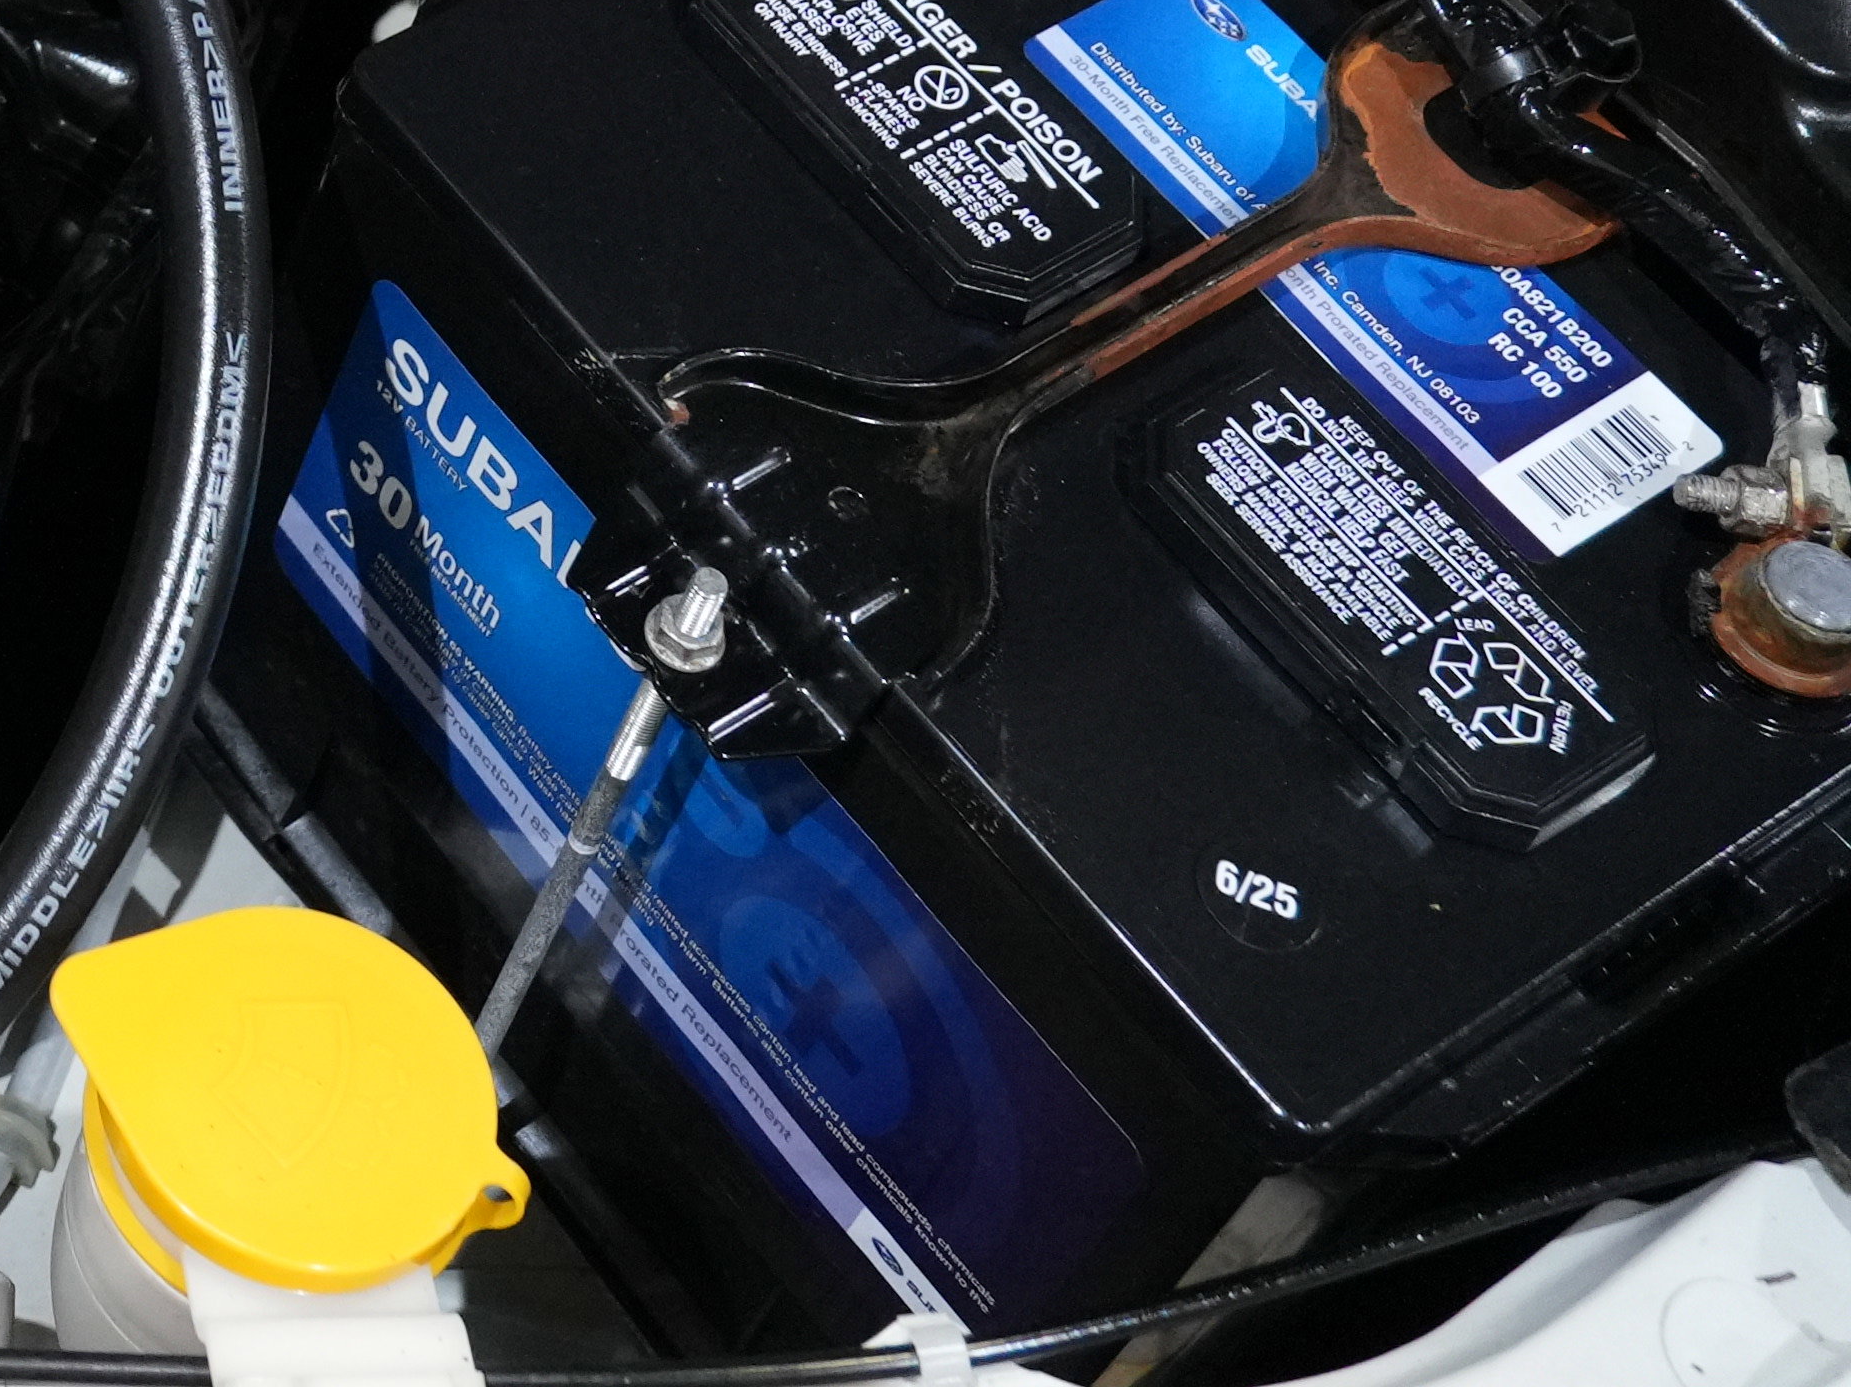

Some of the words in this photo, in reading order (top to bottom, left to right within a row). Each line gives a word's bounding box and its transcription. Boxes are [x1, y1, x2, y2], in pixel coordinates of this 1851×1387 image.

[750, 1, 776, 22] OR
[767, 18, 812, 58] INJURY
[788, 20, 851, 78] BLINDNESS
[843, 5, 886, 44] EYES
[893, 84, 929, 114] NO
[987, 77, 1103, 184] POISON
[905, 160, 957, 207] SEVERE
[949, 205, 998, 249] BURNS
[919, 153, 991, 221] BLINDNESS
[984, 219, 1012, 242] OR
[932, 146, 966, 175] CAN
[958, 172, 1006, 216] CAUSE
[944, 137, 1021, 208] SULFURIC
[1010, 203, 1056, 243] ACID
[1067, 53, 1133, 115] 30-Month
[1127, 113, 1163, 146] Free
[1315, 299, 1380, 361] Prorated
[1374, 360, 1470, 452] Replacement
[1088, 39, 1168, 114] Distributed
[1157, 111, 1190, 138] by:
[1182, 134, 1240, 186] Subaru
[1231, 183, 1257, 204] of
[1310, 260, 1345, 290] Inc.
[1337, 288, 1411, 357] Camden,
[1404, 353, 1434, 379] NJ
[1427, 375, 1482, 425] 08103
[1486, 330, 1526, 364] RC
[1516, 358, 1565, 400] 100
[1499, 304, 1551, 349] CCA
[1541, 343, 1590, 385] 550
[373, 377, 402, 416] 12V
[402, 413, 468, 496] BATTERY
[344, 435, 418, 536] 30
[411, 512, 504, 633] Month
[1192, 441, 1249, 493] OWNERS
[1288, 539, 1310, 557] IF
[1301, 554, 1334, 583] NOT
[1327, 579, 1394, 642] AVAILABLE
[1202, 471, 1241, 506] SEEK
[1231, 502, 1287, 554] SERVICE
[1208, 437, 1263, 488] FOLLOW
[1253, 484, 1342, 568] INSTRUCTIONS
[1333, 565, 1354, 582] IN
[1348, 580, 1401, 630] VEHICLE
[1281, 460, 1345, 518] MEDICAL
[1333, 513, 1378, 553] HELP
[1367, 546, 1410, 584] FAST
[1296, 451, 1340, 489] WITH
[1375, 529, 1411, 561] GET
[1312, 441, 1362, 486] FLUSH
[1351, 482, 1395, 521] EYES
[1385, 515, 1475, 599] IMMEDIATELY
[1336, 414, 1377, 451] KEEP
[1369, 448, 1405, 480] OUT
[1399, 477, 1426, 501] OF
[1421, 499, 1456, 529] THE
[1448, 526, 1500, 573] REACH
[1493, 570, 1522, 594] OF
[1514, 591, 1587, 660] CHILDREN
[1574, 482, 1623, 517] 21112
[1268, 478, 1301, 507] FOR
[1292, 503, 1331, 538] SAFE
[1321, 534, 1362, 571] JUMP
[1353, 566, 1419, 627] STARTING
[1299, 395, 1328, 420] DO
[1320, 418, 1355, 448] NOT
[1375, 473, 1416, 510] KEEP
[1410, 507, 1451, 544] VENT
[1445, 542, 1488, 581] CAPS
[1484, 581, 1529, 622] TIGHT
[1525, 622, 1559, 652] AND
[1554, 652, 1602, 695] LEVEL
[429, 563, 491, 641] REPLACEMENT
[1454, 619, 1494, 631] LEAD
[1414, 685, 1486, 751] RECYCLE
[1549, 700, 1572, 754] RETURN
[311, 541, 384, 634] Extended
[380, 629, 445, 712] Battery
[439, 702, 521, 806] Protection
[678, 1002, 796, 1143] Replacement
[1215, 859, 1298, 919] 6/25
